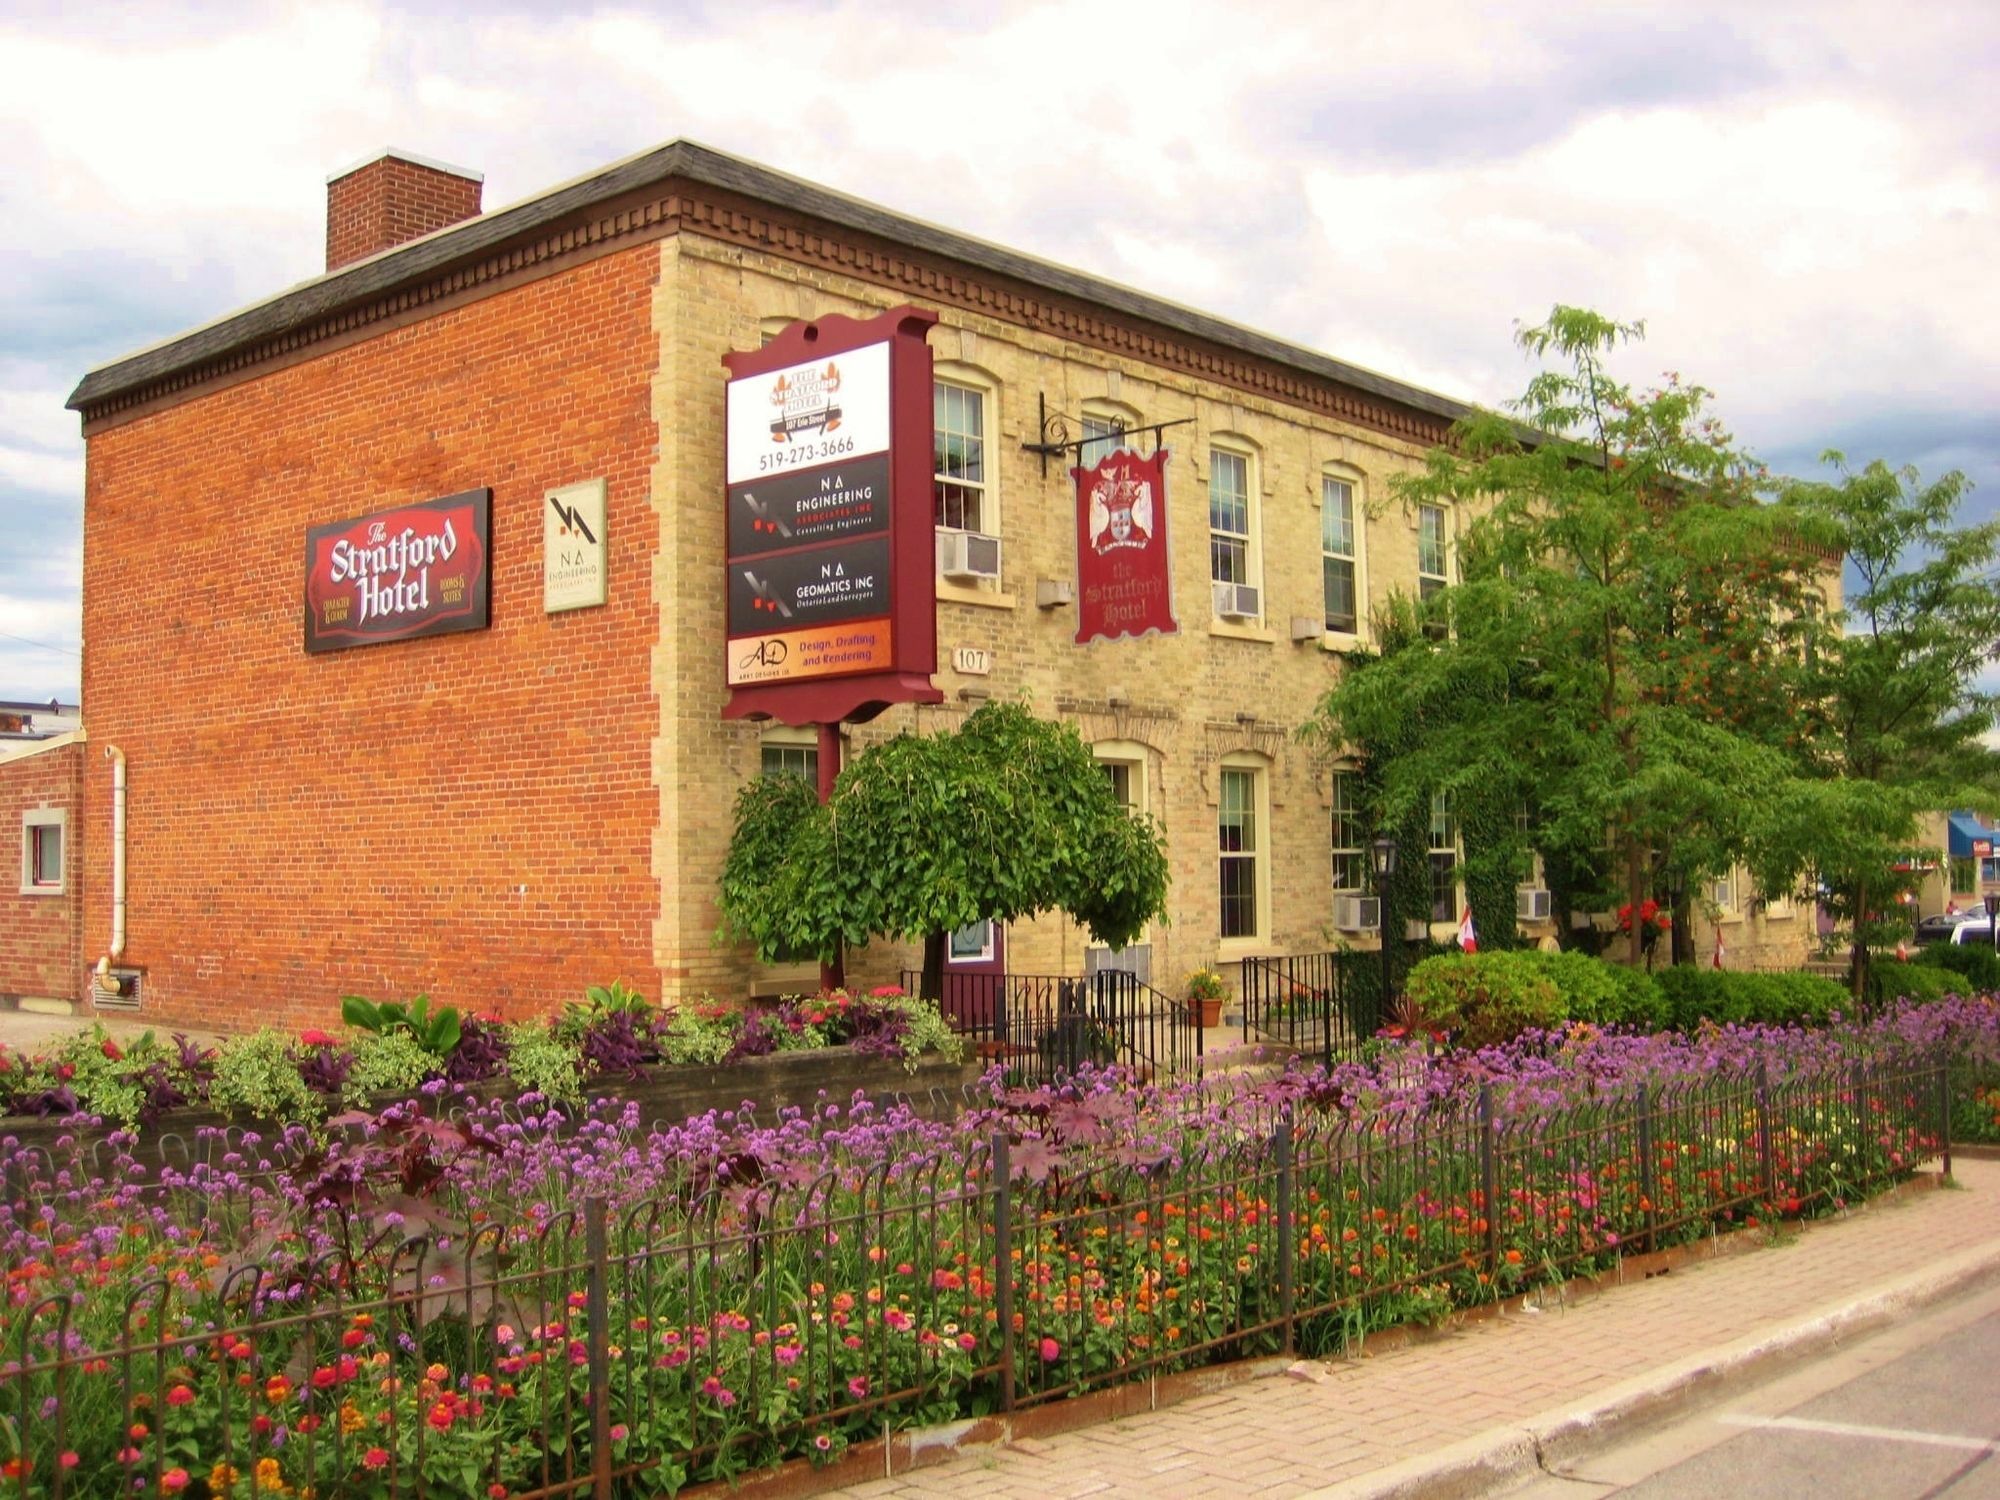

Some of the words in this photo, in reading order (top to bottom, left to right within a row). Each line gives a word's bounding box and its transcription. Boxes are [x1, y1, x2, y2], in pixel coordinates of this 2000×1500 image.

[760, 436, 854, 471] 519-273-3666
[796, 486, 872, 513] ENGINEERING
[367, 521, 387, 545] The
[330, 517, 457, 583] Stratford
[354, 566, 430, 628] Hotel
[796, 579, 851, 599] GEOMATICS
[855, 575, 873, 590] INC
[836, 634, 875, 648] Drafting
[803, 656, 820, 667] and
[823, 650, 872, 665] Rendering
[959, 649, 984, 670] 107
